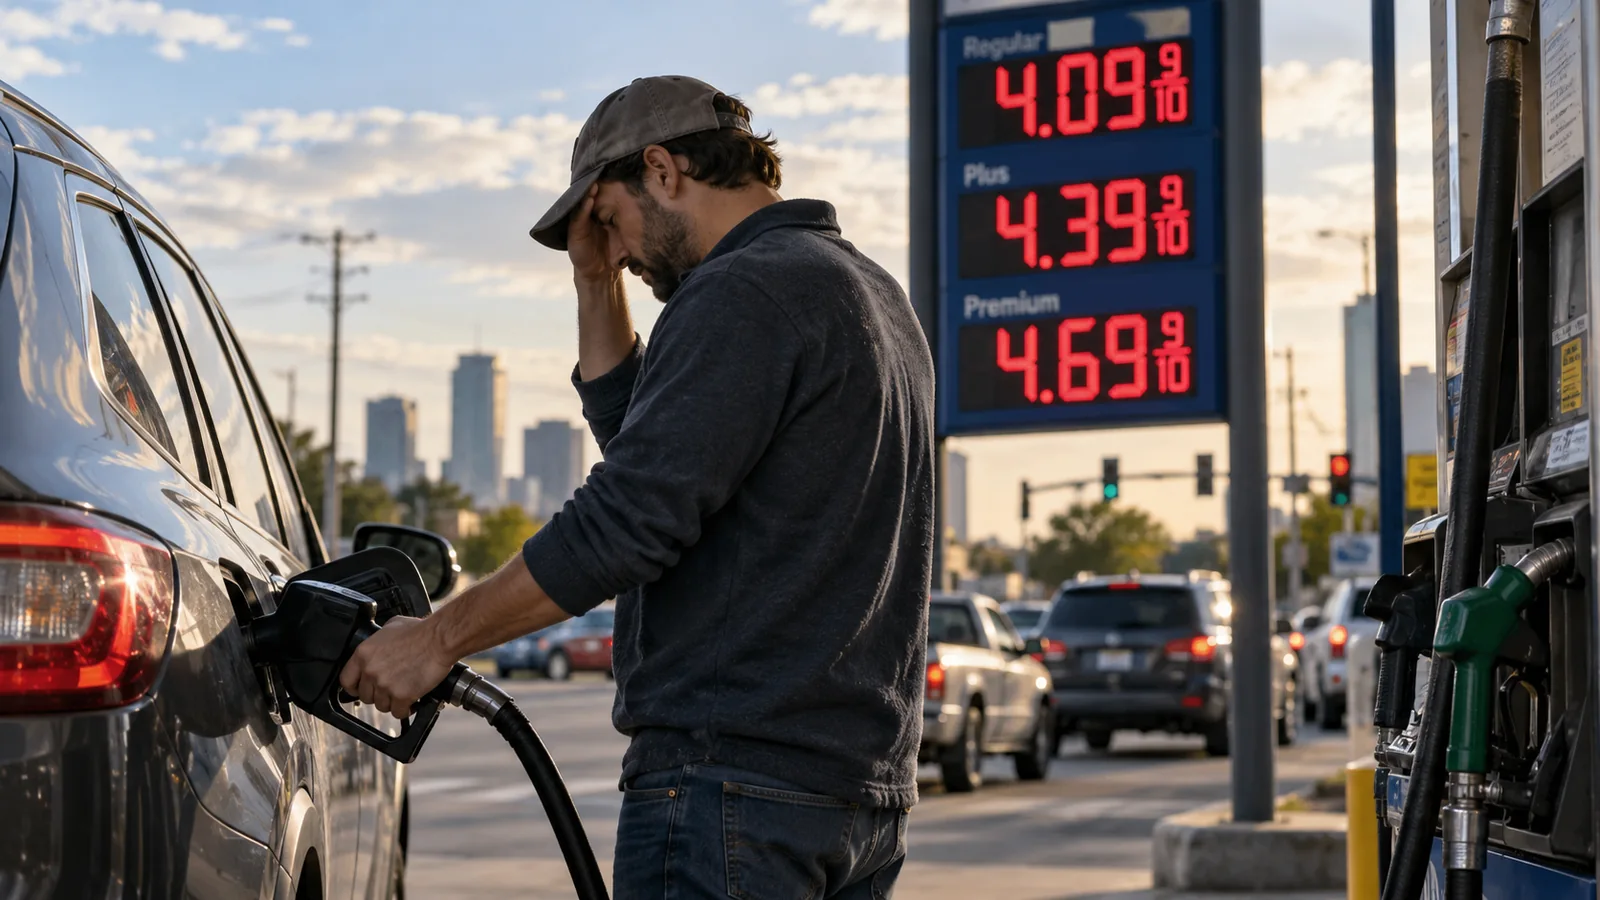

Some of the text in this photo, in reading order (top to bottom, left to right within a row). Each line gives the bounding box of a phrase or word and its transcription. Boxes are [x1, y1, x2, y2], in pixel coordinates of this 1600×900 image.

[963, 30, 1044, 61] Regular
[995, 46, 1146, 137] 4.09
[964, 161, 1010, 188] Plus
[996, 178, 1147, 270] 4.39
[964, 289, 1060, 319] Premium
[996, 313, 1148, 404] 4.69
